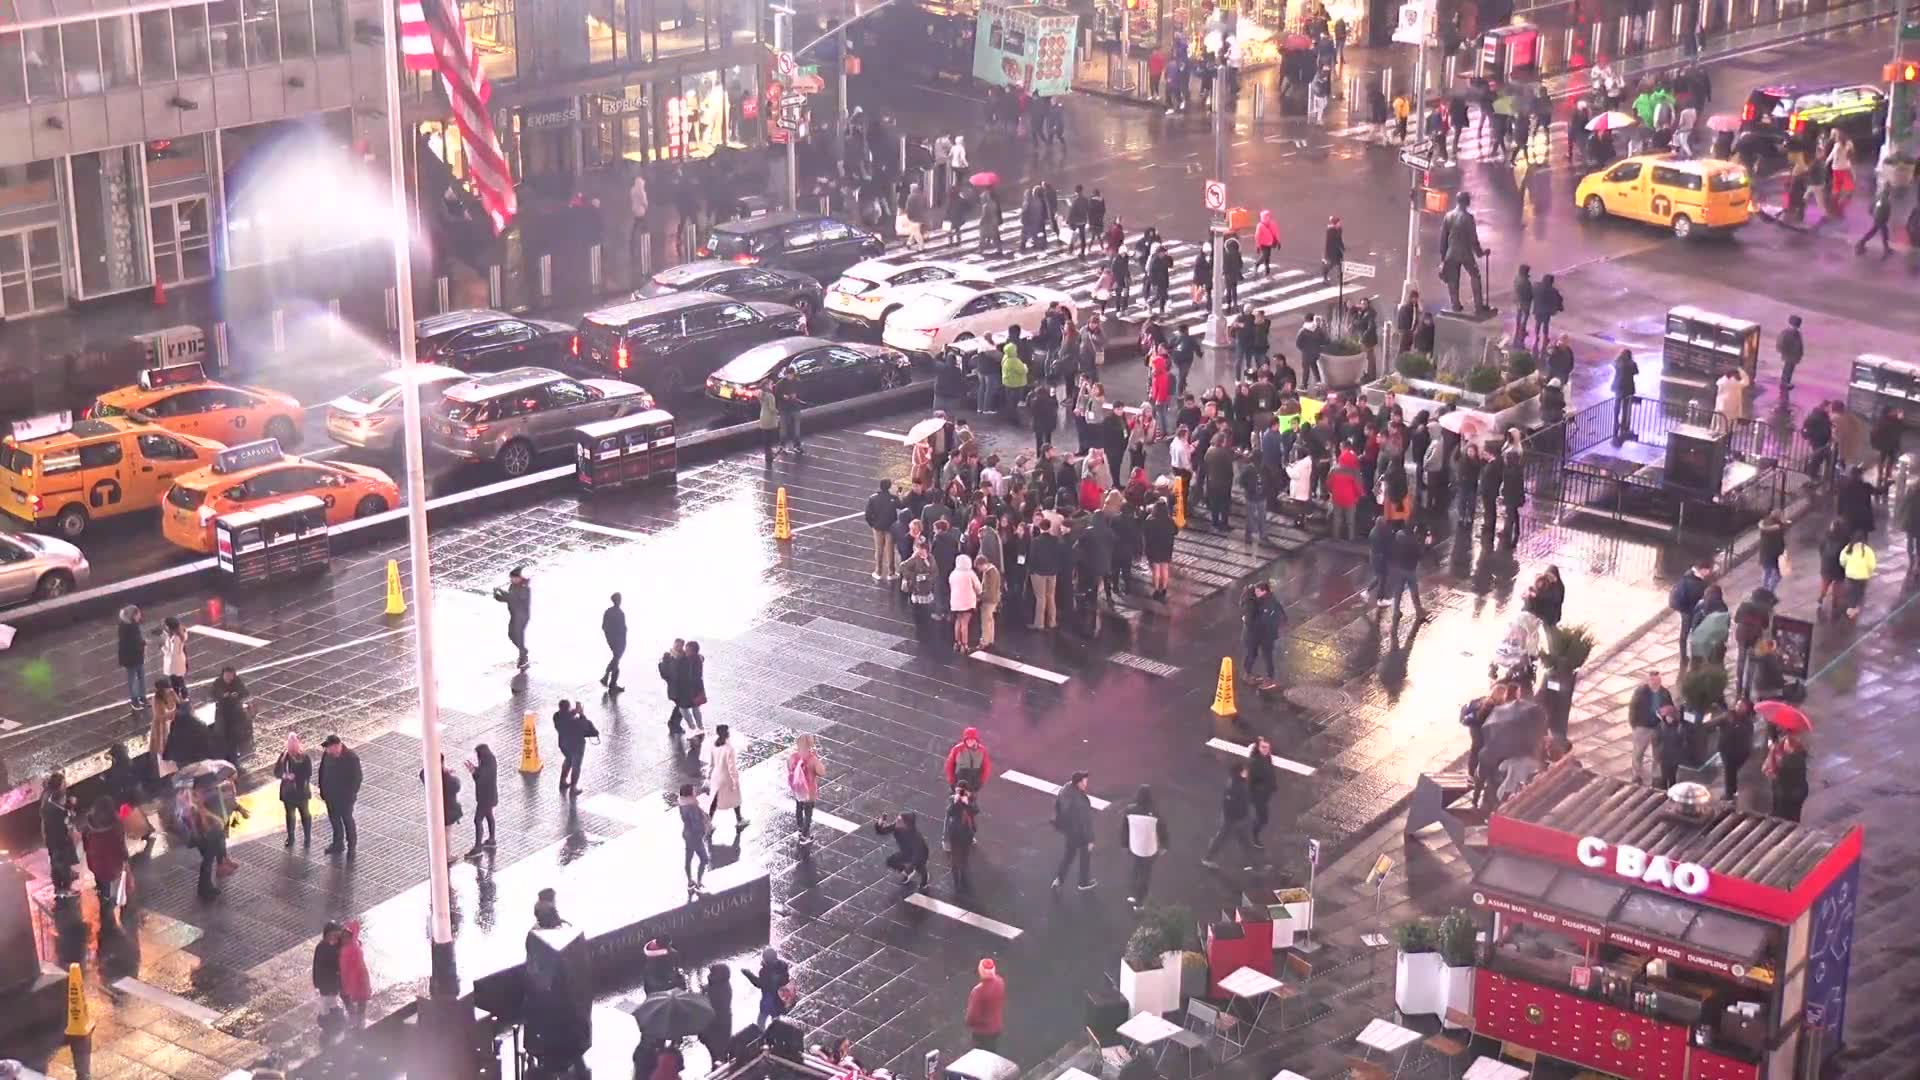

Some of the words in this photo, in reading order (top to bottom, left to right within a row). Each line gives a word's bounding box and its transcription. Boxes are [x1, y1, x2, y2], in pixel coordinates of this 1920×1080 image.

[527, 110, 577, 128] EXPRESS
[602, 97, 648, 113] EXPRESS
[1576, 836, 1607, 867] C
[1615, 844, 1710, 895] BAO
[1487, 899, 1510, 910] ASIAN
[1511, 904, 1527, 914] BUN
[1533, 911, 1556, 922] BAOZI
[1562, 919, 1601, 935] DUMPLING
[1610, 932, 1633, 944] ASIAN
[1634, 938, 1651, 950] BUN
[1657, 945, 1681, 958] BAOZI
[1687, 954, 1728, 970] DUMPLING
